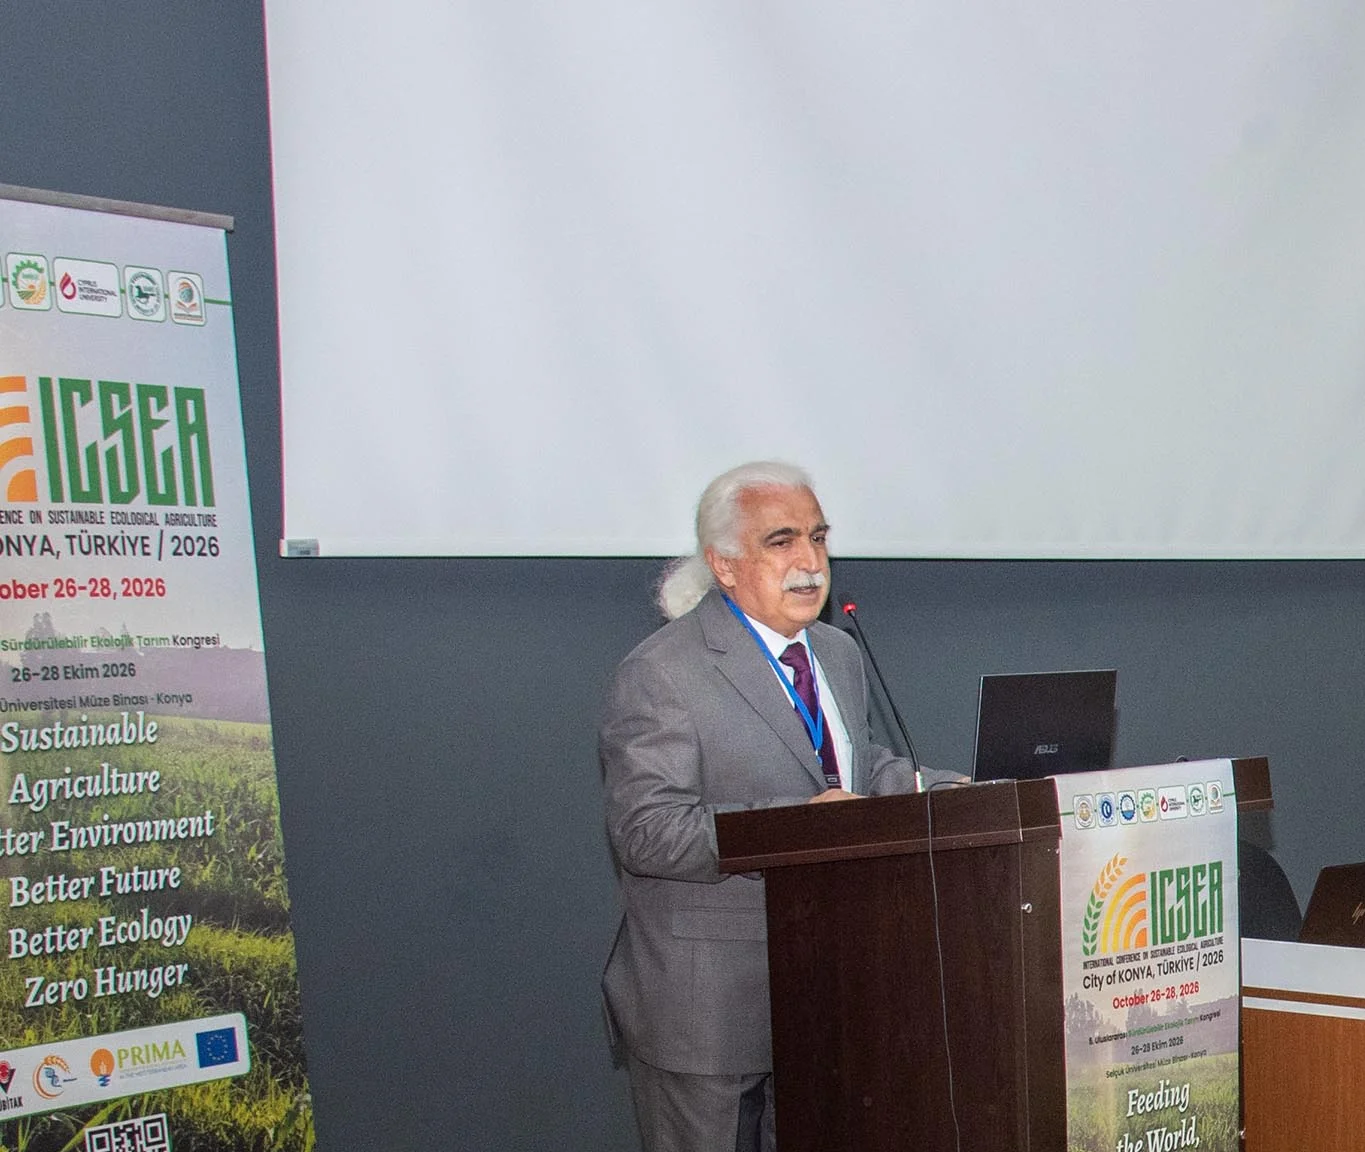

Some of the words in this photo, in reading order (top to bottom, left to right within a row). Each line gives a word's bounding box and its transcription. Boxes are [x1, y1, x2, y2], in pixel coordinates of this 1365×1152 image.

[38, 376, 215, 507] ICSEA
[30, 511, 42, 524] ON
[48, 511, 105, 526] SUSTAINABLE
[111, 513, 160, 527] ECOLOGICAL
[165, 514, 217, 528] AGRICULTURE
[66, 530, 151, 557] TÜRKİYE
[158, 530, 164, 561] /
[172, 535, 220, 558] 2026
[54, 578, 117, 601] 26-28,
[122, 578, 166, 598] 2026
[1, 636, 88, 652] Sürdürülebilir
[91, 636, 134, 652] Ekolojik
[136, 634, 170, 648] Tarım
[173, 634, 221, 650] Kongresi
[12, 664, 60, 683] 26-28
[64, 664, 100, 681] Ekim
[103, 663, 136, 678] 2026
[0, 694, 78, 713] Üniversitesi
[80, 694, 110, 708] Müze
[113, 694, 148, 707] Binası
[156, 692, 192, 707] Konya
[1, 712, 158, 753] Sustainable
[8, 763, 161, 813] Agriculture
[50, 810, 214, 852] Environment
[10, 874, 95, 908] Better
[100, 865, 182, 897] Future
[1150, 860, 1224, 946] ICSEA
[9, 925, 94, 959] Better
[100, 909, 192, 948] Ecology
[1082, 958, 1114, 970] INTERNATIONAL
[1116, 952, 1140, 965] CONFERENCE
[1142, 951, 1148, 960] ON
[1150, 946, 1175, 958] SUSTAINABLE
[1177, 942, 1198, 954] ECOLOGICAL
[1200, 936, 1224, 948] AGRICULTURE
[26, 976, 88, 1008] Zero
[94, 963, 188, 999] Hunger
[1082, 974, 1104, 991] City
[1106, 970, 1117, 985] of
[1118, 965, 1155, 983] KONYA,
[1157, 956, 1194, 976] TÜRKİYE
[1202, 950, 1224, 967] 2026
[1112, 993, 1149, 1010] October
[1150, 986, 1178, 1002] 26-28,
[1180, 981, 1200, 997] 2026
[117, 1039, 187, 1069] PRIMA
[1131, 1042, 1150, 1056] 26-28
[1152, 1040, 1168, 1052] Ekim
[1168, 1036, 1184, 1048] 2026
[1106, 1069, 1124, 1079] Selçuk
[0, 1096, 24, 1112] BİTAK
[1126, 1080, 1190, 1117] Feeding
